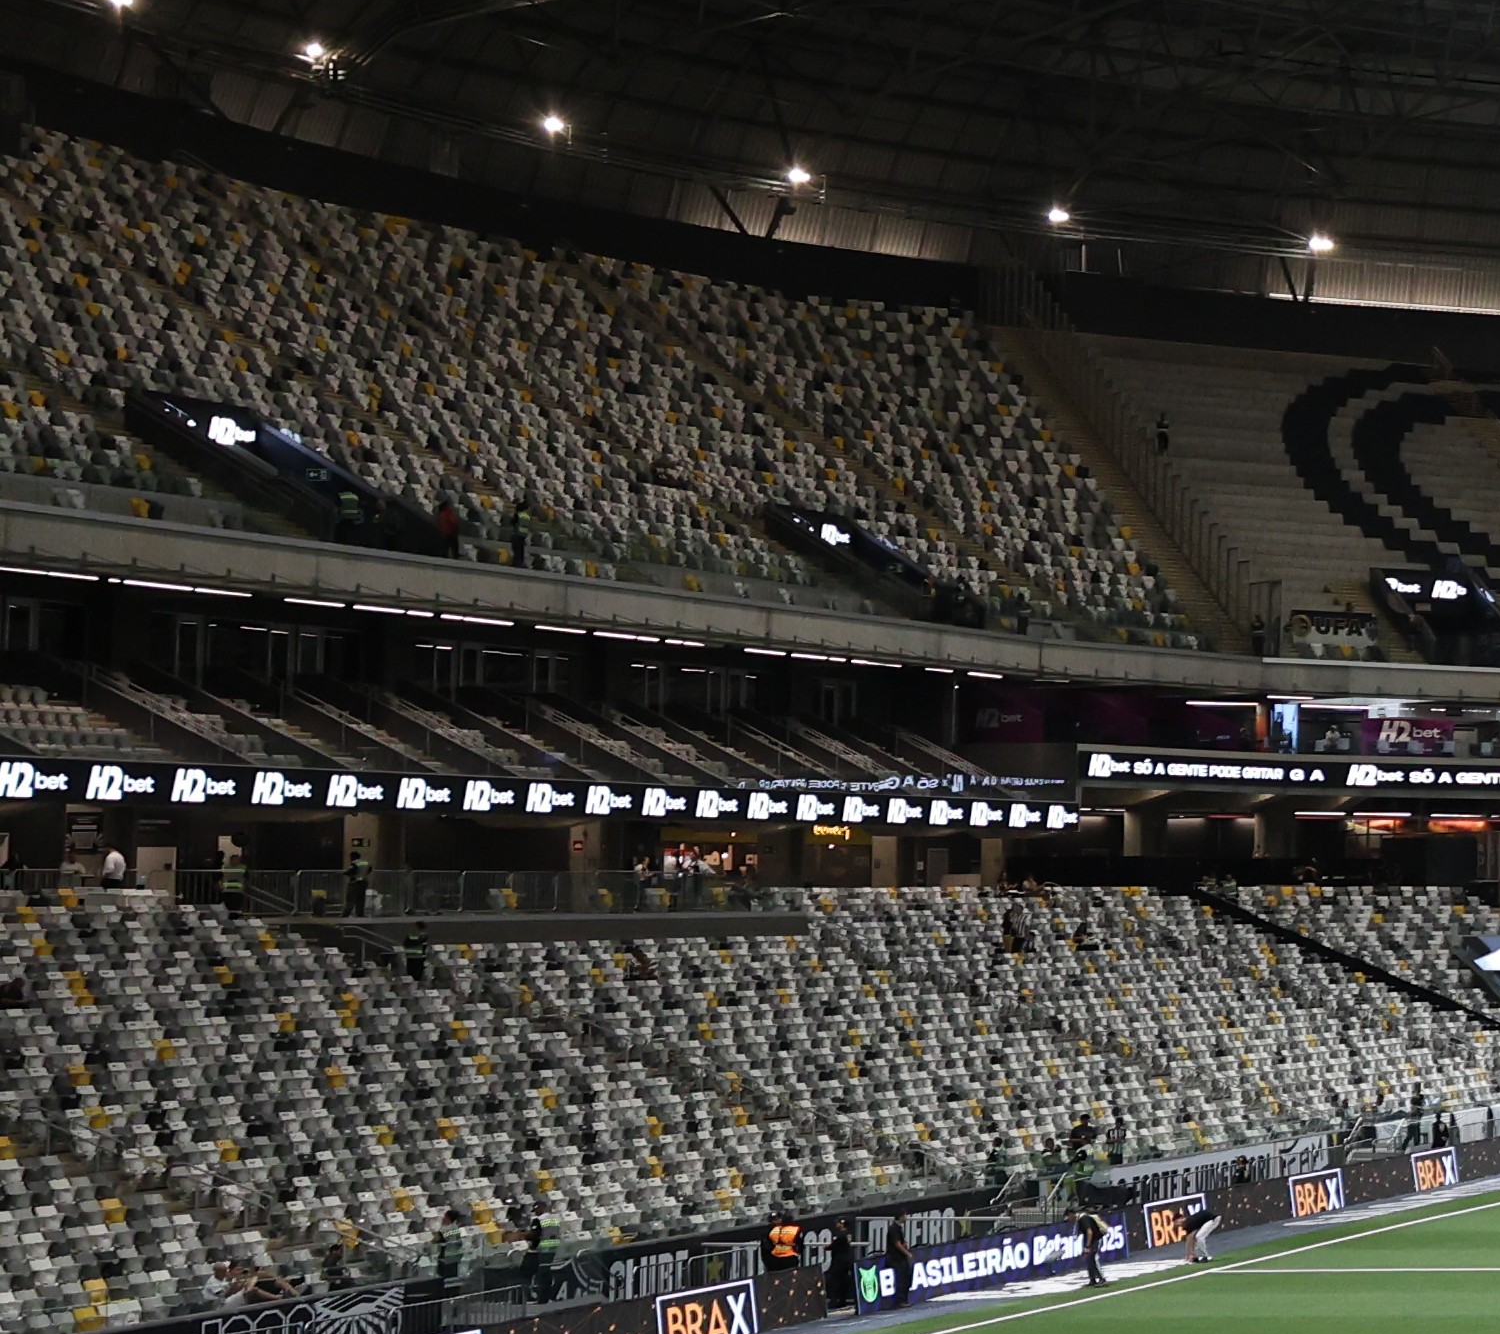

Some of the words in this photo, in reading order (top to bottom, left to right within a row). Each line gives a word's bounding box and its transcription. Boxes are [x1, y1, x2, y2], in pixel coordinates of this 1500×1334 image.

[1154, 763, 1166, 776] A
[1167, 764, 1207, 778] GENTE
[1208, 765, 1242, 779] PODE
[1243, 767, 1284, 780] GRITAR
[1438, 772, 1453, 784] A
[1418, 1155, 1457, 1190] BRAX
[1294, 1177, 1341, 1218] BRAX
[879, 1238, 1029, 1297] BASILEIRÃO
[1034, 1233, 1084, 1265] Betan
